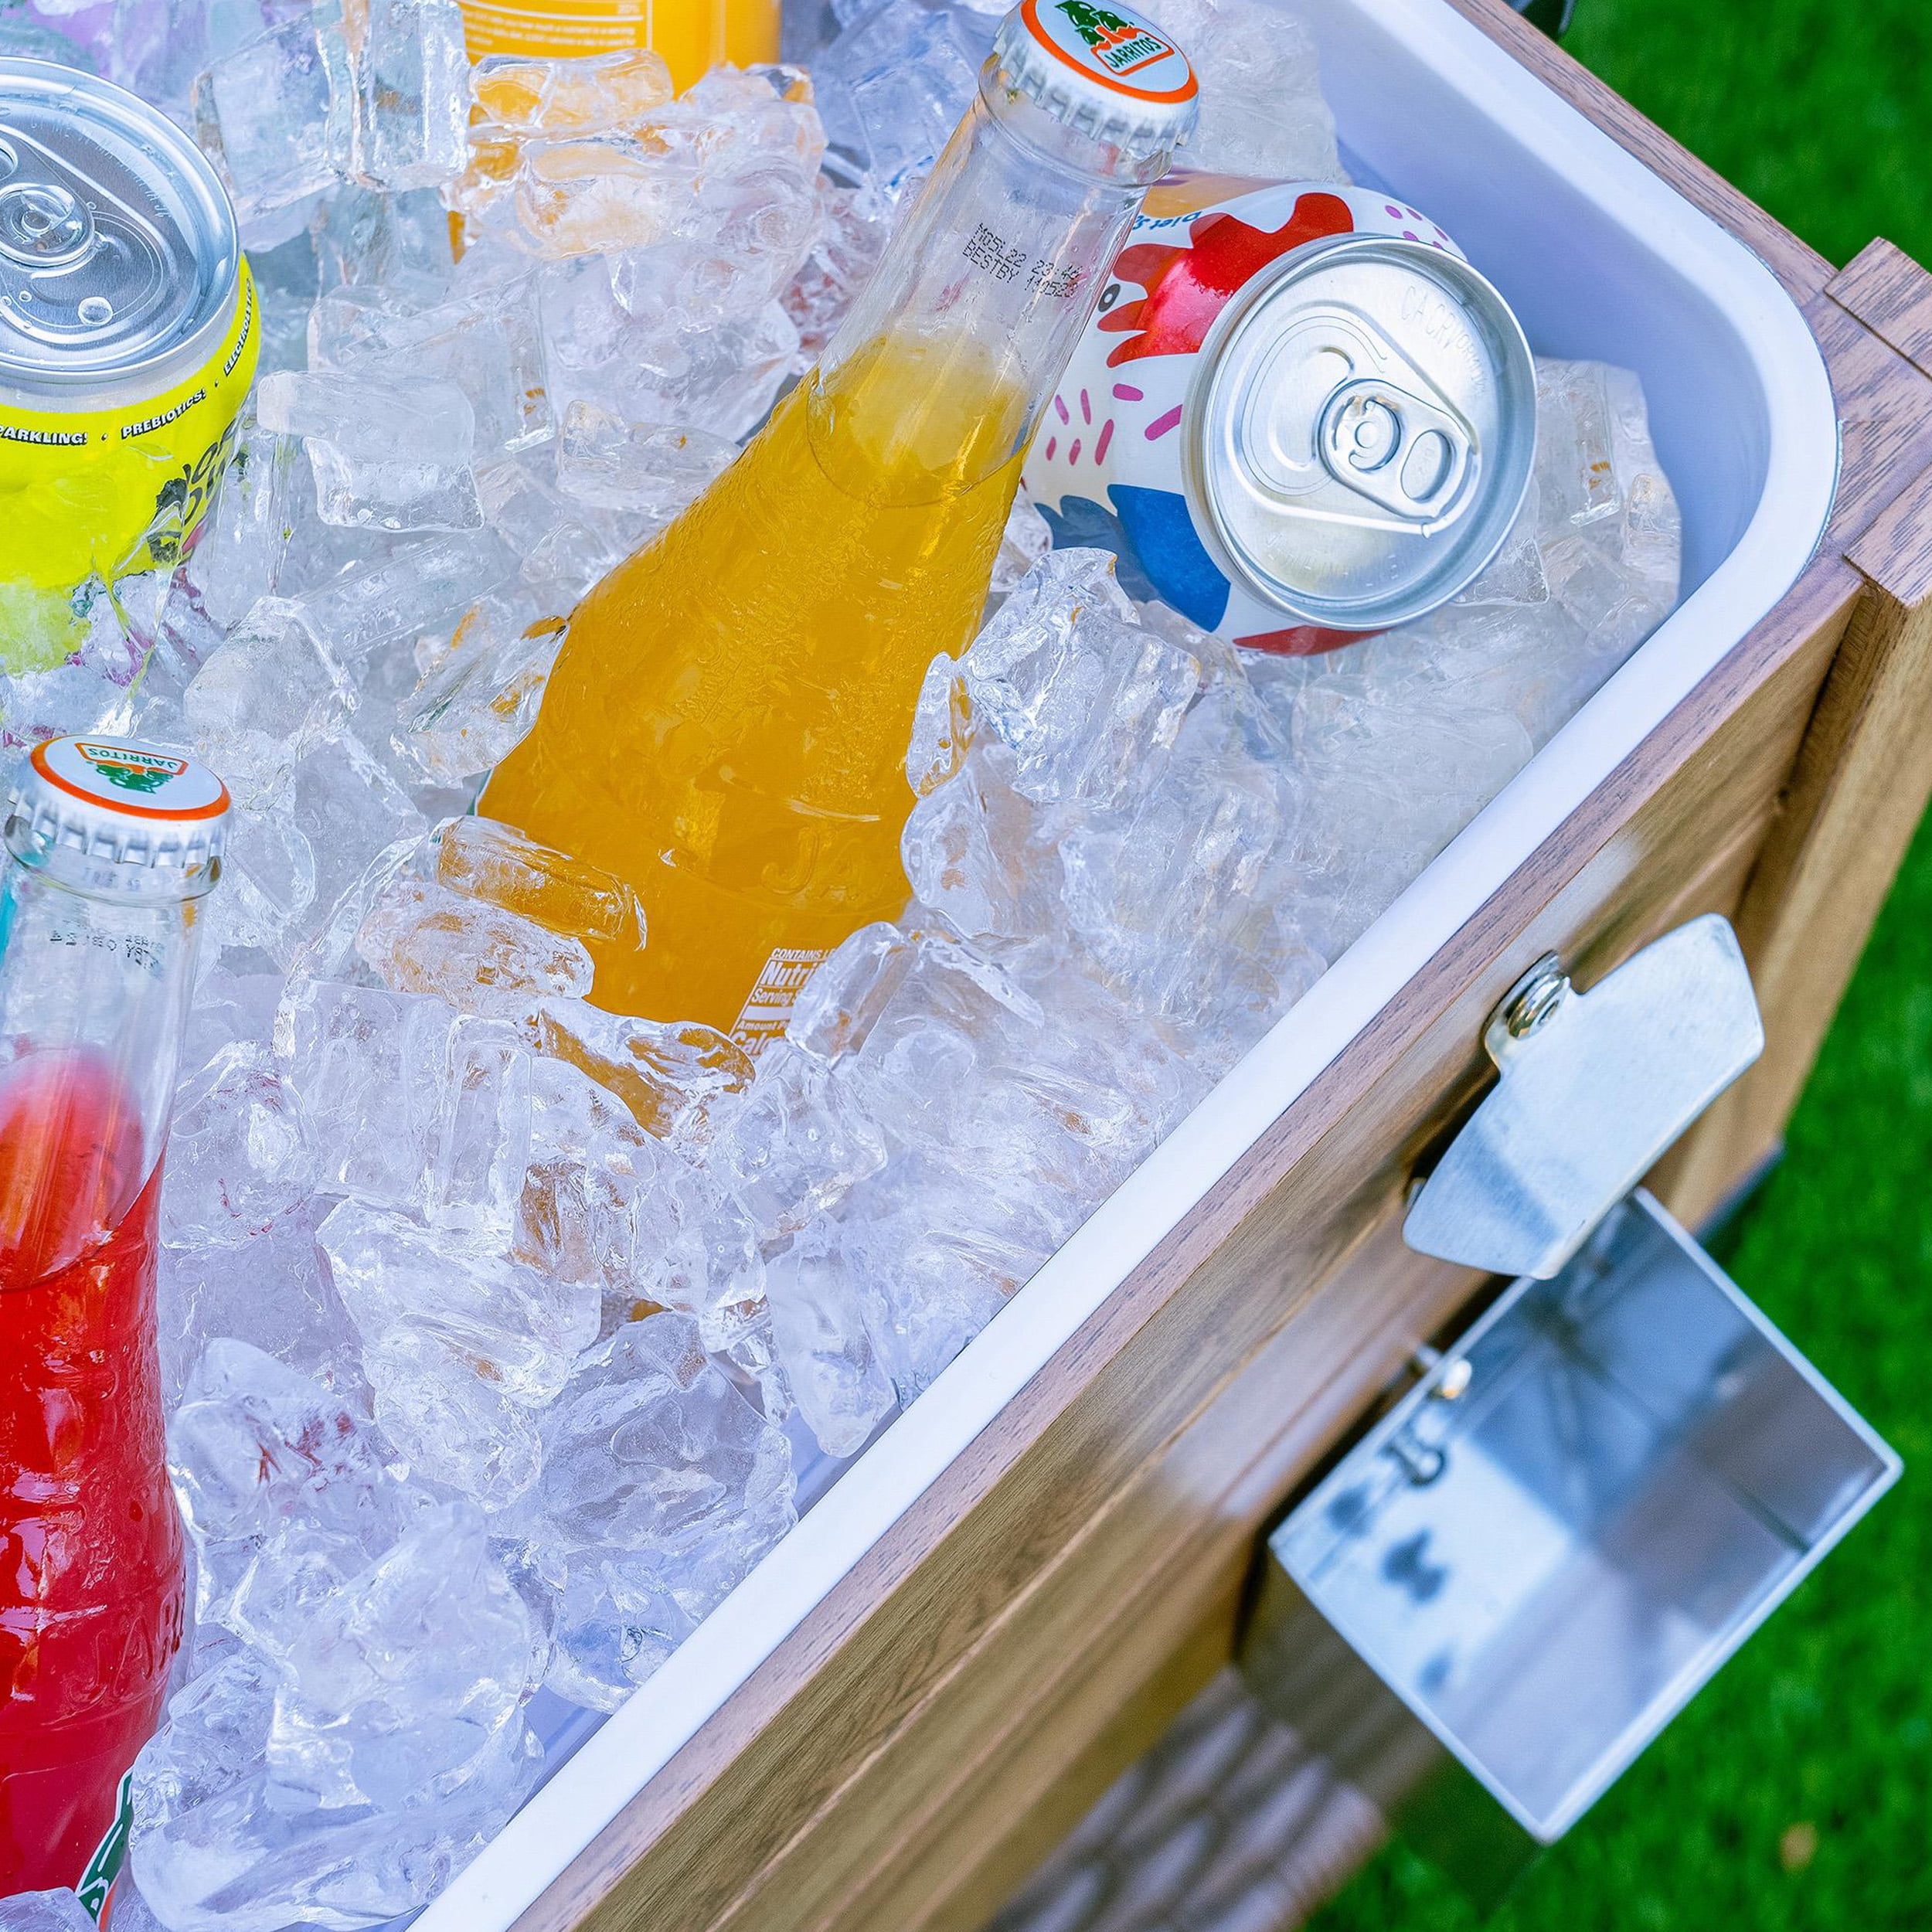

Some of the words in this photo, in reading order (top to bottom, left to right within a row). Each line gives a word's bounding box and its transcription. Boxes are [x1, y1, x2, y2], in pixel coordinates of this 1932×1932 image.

[1104, 36, 1162, 68] JARRITOS
[1148, 212, 1202, 230] Diet
[962, 240, 1019, 283] BESTBY
[121, 388, 206, 439] PREBIOTICS!
[88, 747, 179, 768] JARRITOS
[771, 947, 822, 960] CONTAINS
[751, 988, 794, 1006] Serving
[737, 1020, 777, 1030] Amount
